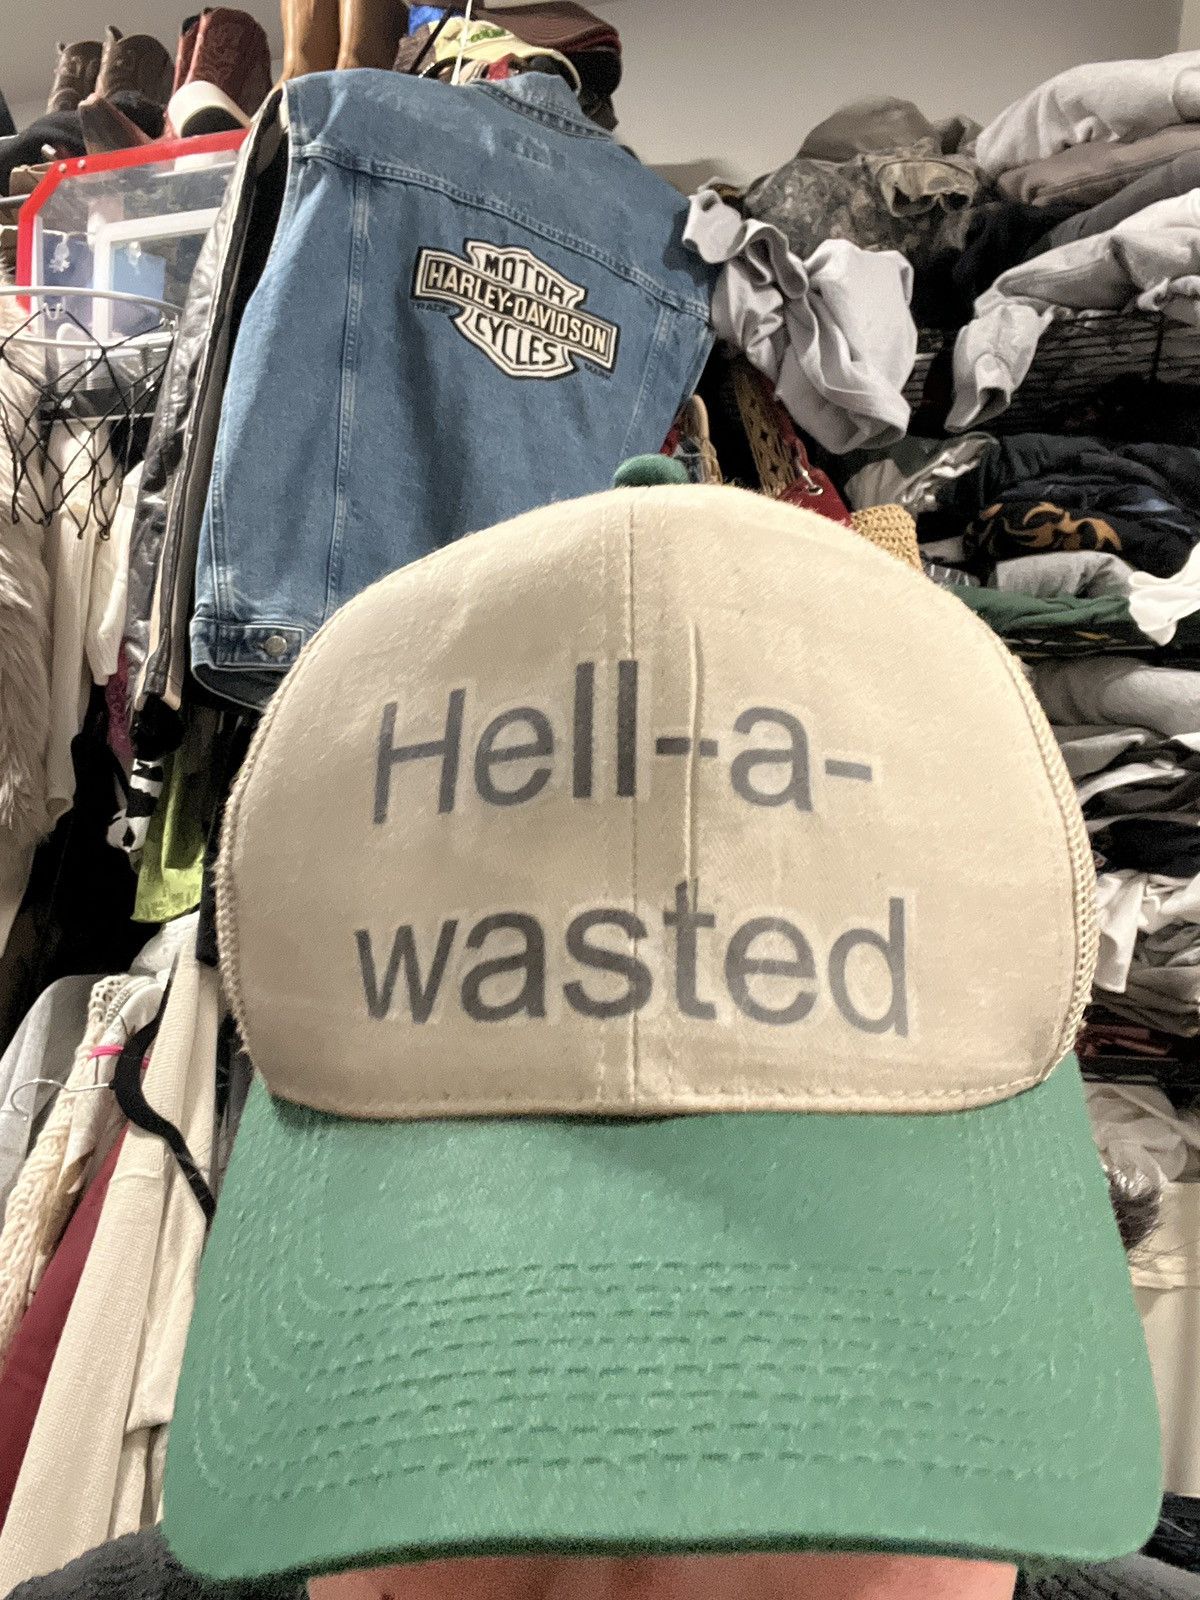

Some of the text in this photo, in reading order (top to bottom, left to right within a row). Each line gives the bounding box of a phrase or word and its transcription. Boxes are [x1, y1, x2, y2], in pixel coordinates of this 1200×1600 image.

[428, 261, 608, 354] HARLEY-DAVIDSON
[484, 254, 565, 304] MOTOR
[475, 313, 557, 366] CYCLES
[372, 660, 873, 825] Hell-a-
[355, 877, 909, 1037] wasted
